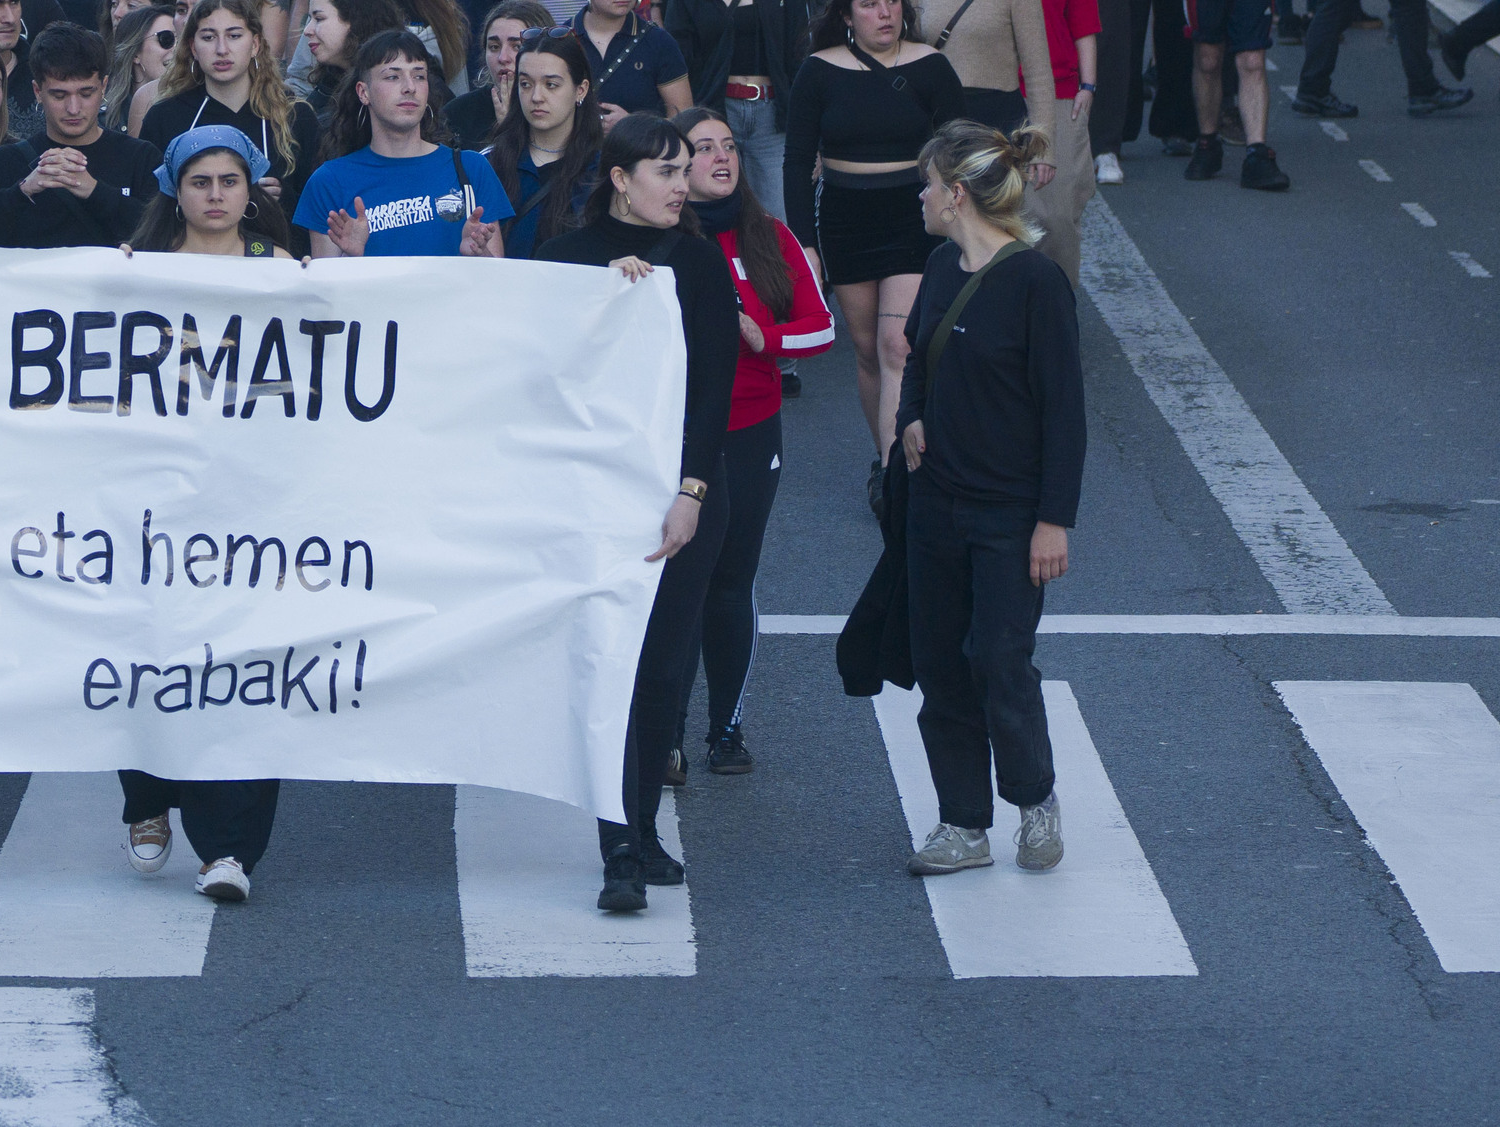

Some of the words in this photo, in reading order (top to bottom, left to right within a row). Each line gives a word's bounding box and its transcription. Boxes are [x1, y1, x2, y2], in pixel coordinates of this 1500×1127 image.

[9, 308, 398, 423] BERMATU
[10, 510, 114, 585] eta
[140, 507, 374, 592] hemen
[82, 638, 368, 715] erabaki!
